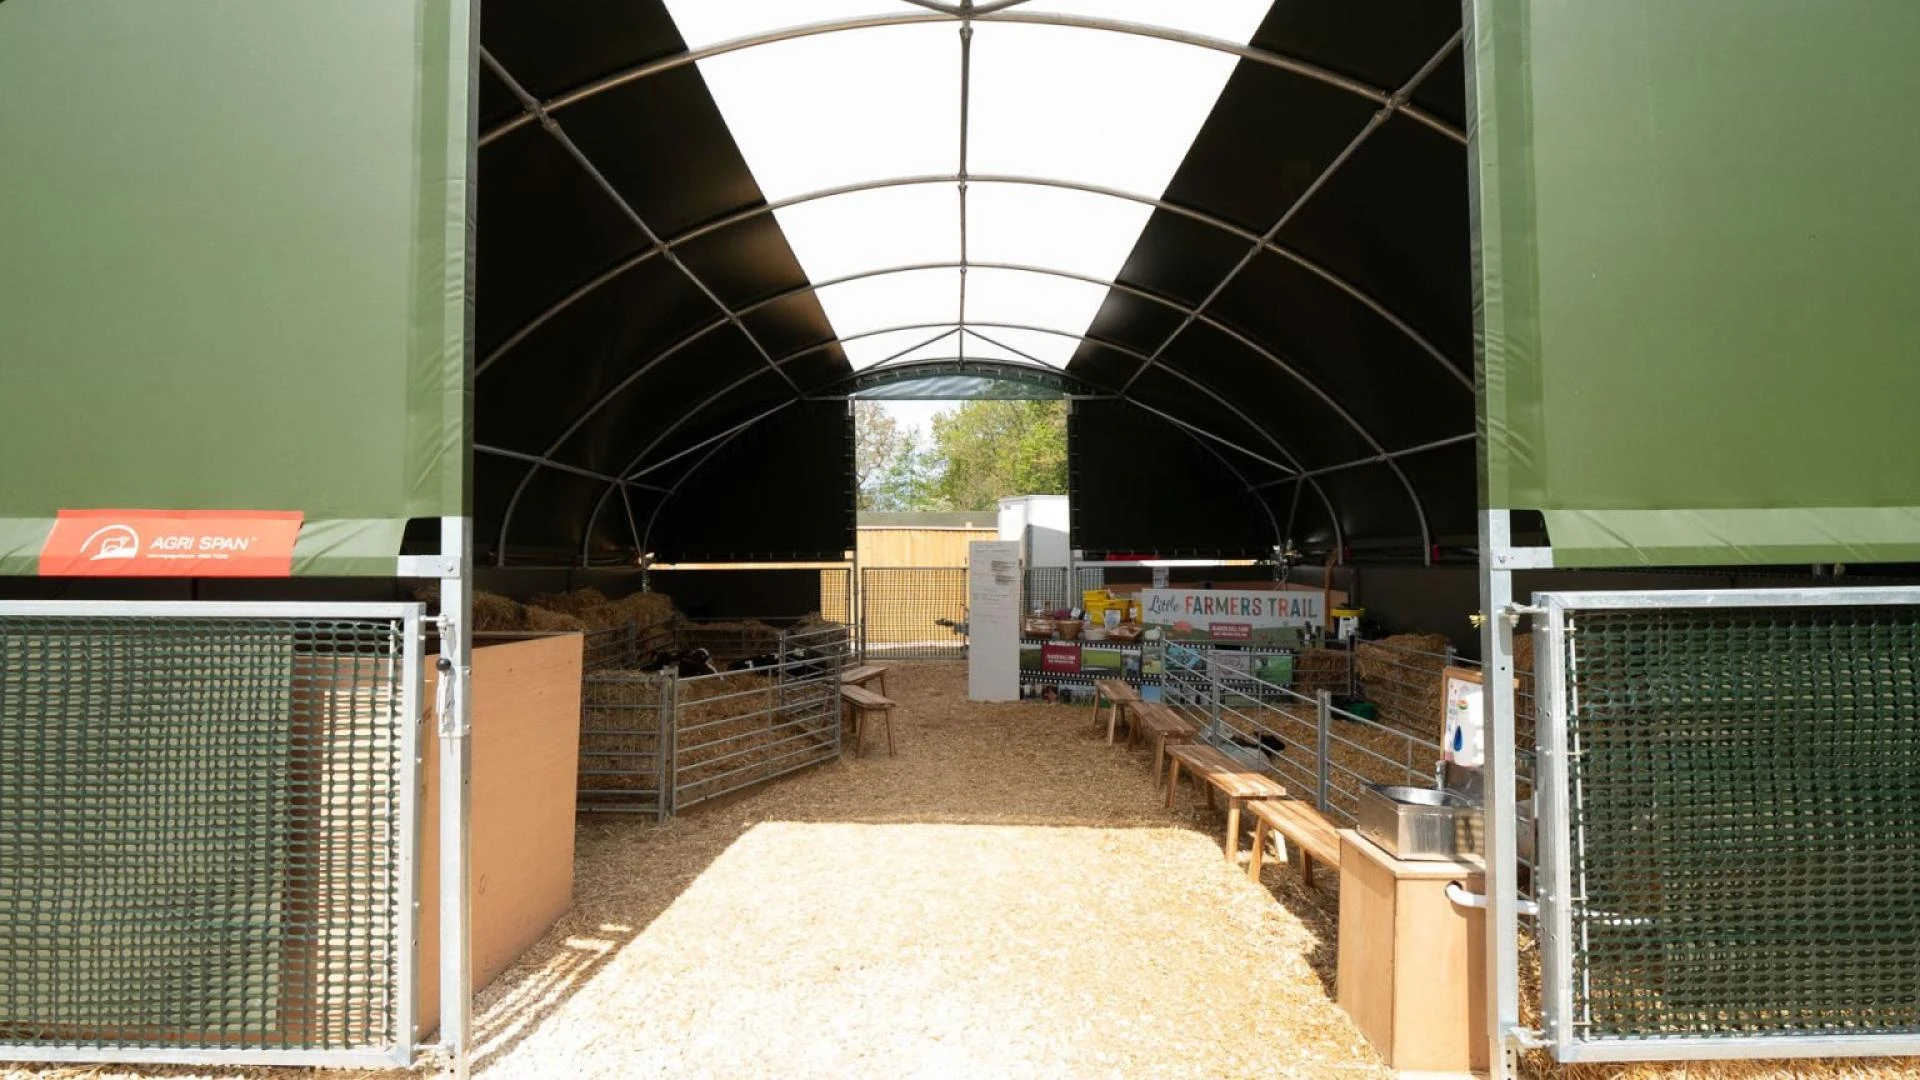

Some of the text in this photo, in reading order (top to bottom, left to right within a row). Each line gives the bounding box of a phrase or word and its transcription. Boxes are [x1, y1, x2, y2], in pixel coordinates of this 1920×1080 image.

[150, 536, 249, 550] AGRI SPAN
[1149, 594, 1317, 617] Little FARMERS TRAIL
